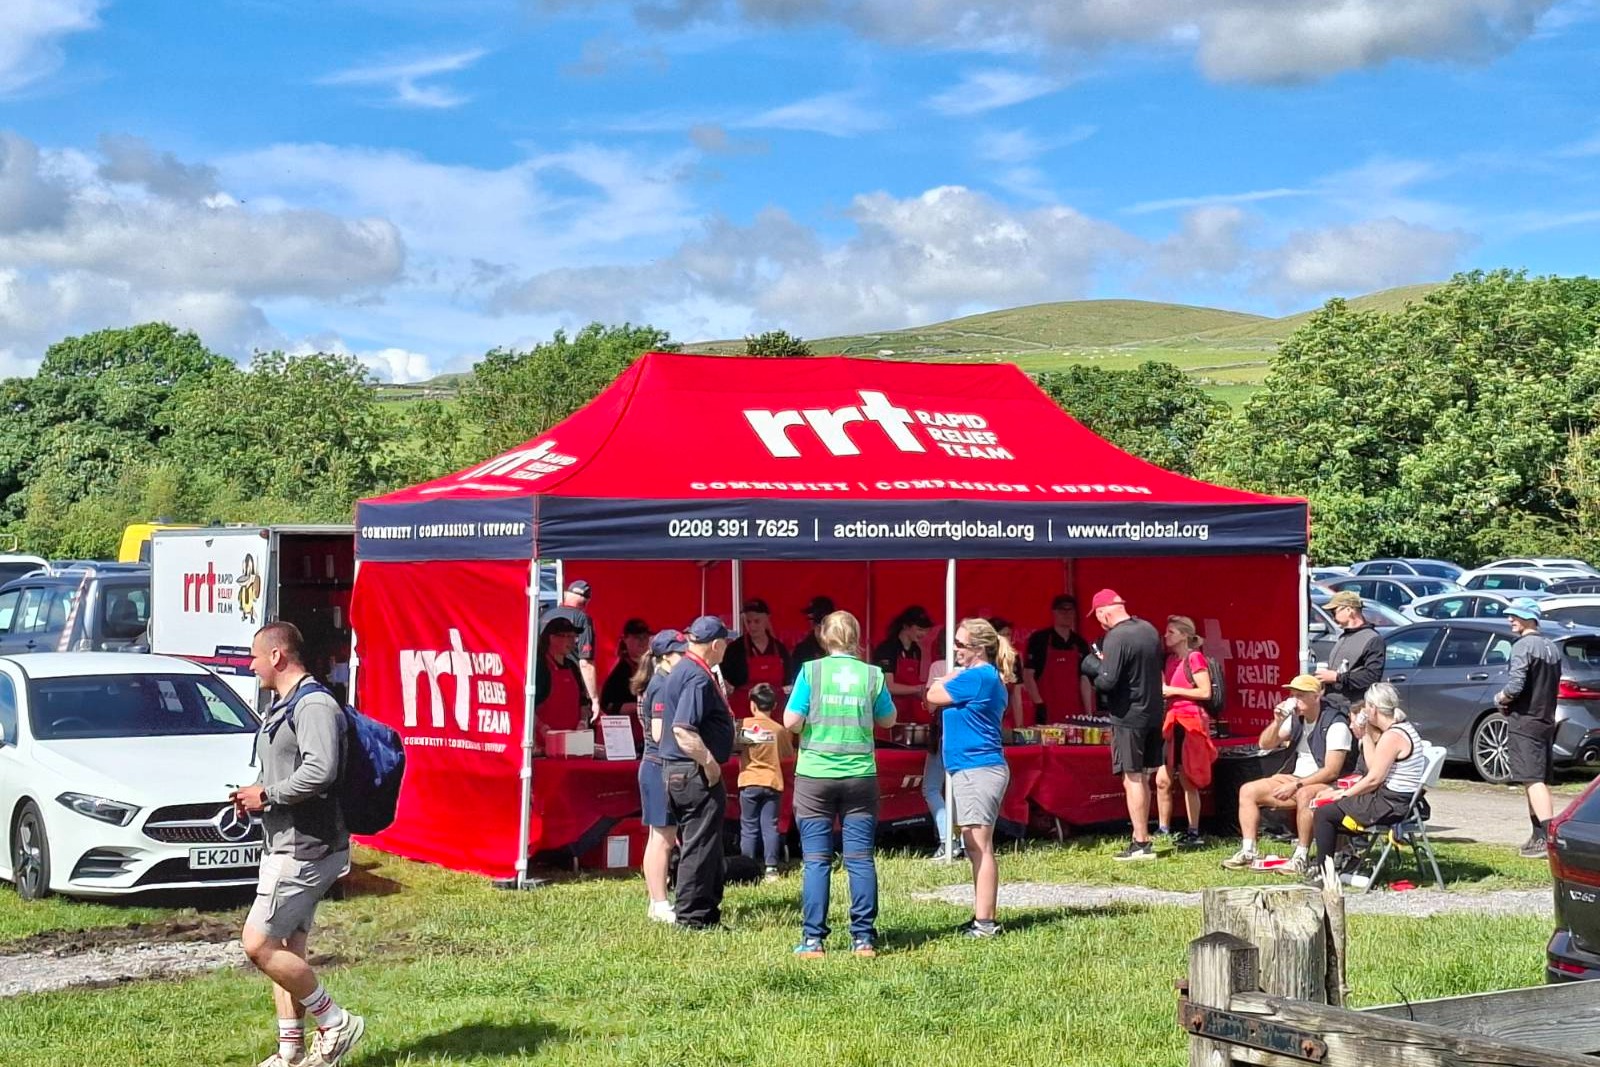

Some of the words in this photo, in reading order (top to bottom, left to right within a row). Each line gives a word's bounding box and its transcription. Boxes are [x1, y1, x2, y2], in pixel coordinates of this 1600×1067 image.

[742, 389, 926, 458] rrt
[914, 410, 987, 429] RAPID
[926, 427, 998, 445] RELIEF
[938, 443, 1014, 461] TEAM
[691, 481, 850, 492] COMMUNITY
[362, 526, 411, 539] COMMUNITY
[419, 523, 475, 538] COMPASSION
[483, 523, 526, 537] SUPPORT
[668, 519, 713, 537] 0208
[717, 520, 748, 537] 391
[756, 520, 799, 537] 7625
[833, 520, 1035, 542] action.uk@rrtglobal.org
[1067, 521, 1209, 541] www.rrtglobal.org
[183, 562, 216, 613] rrt
[217, 573, 234, 585] RAPID
[217, 602, 233, 614] TEAM
[1235, 639, 1280, 660] RAPID
[471, 653, 504, 676] RAPID
[1237, 664, 1280, 685] RELIEF
[400, 628, 473, 732] rrt
[477, 680, 507, 705] RELIEF
[1238, 688, 1282, 709] TEAM
[477, 709, 511, 735] TEAM
[197, 849, 239, 866] EK20
